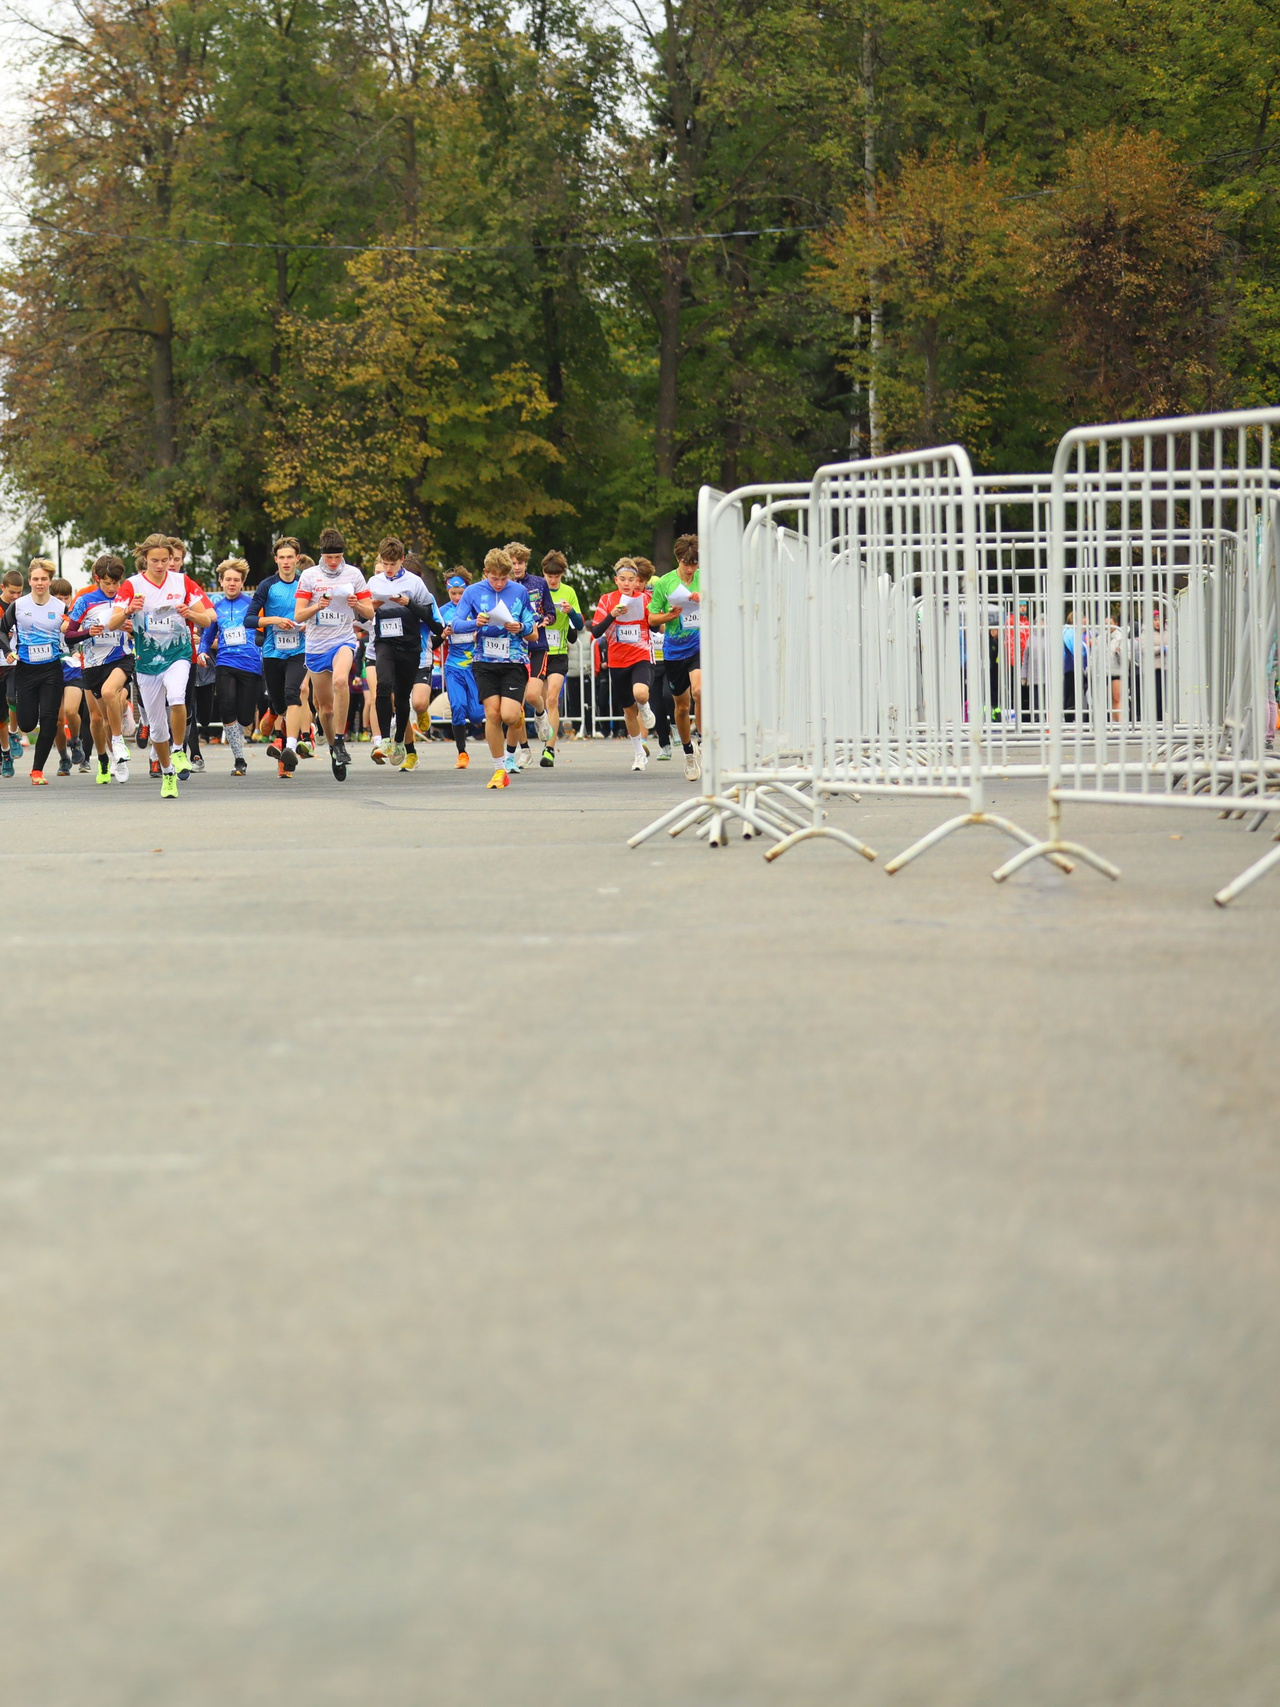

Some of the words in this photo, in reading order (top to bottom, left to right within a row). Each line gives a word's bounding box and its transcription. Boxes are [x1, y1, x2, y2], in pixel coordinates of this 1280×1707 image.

[320, 612, 340, 620] 318.1
[683, 614, 700, 622] 320.
[382, 623, 398, 631] 337.1
[225, 631, 241, 640] 357.1
[619, 629, 638, 637] 340.1
[486, 641, 505, 651] 339.1
